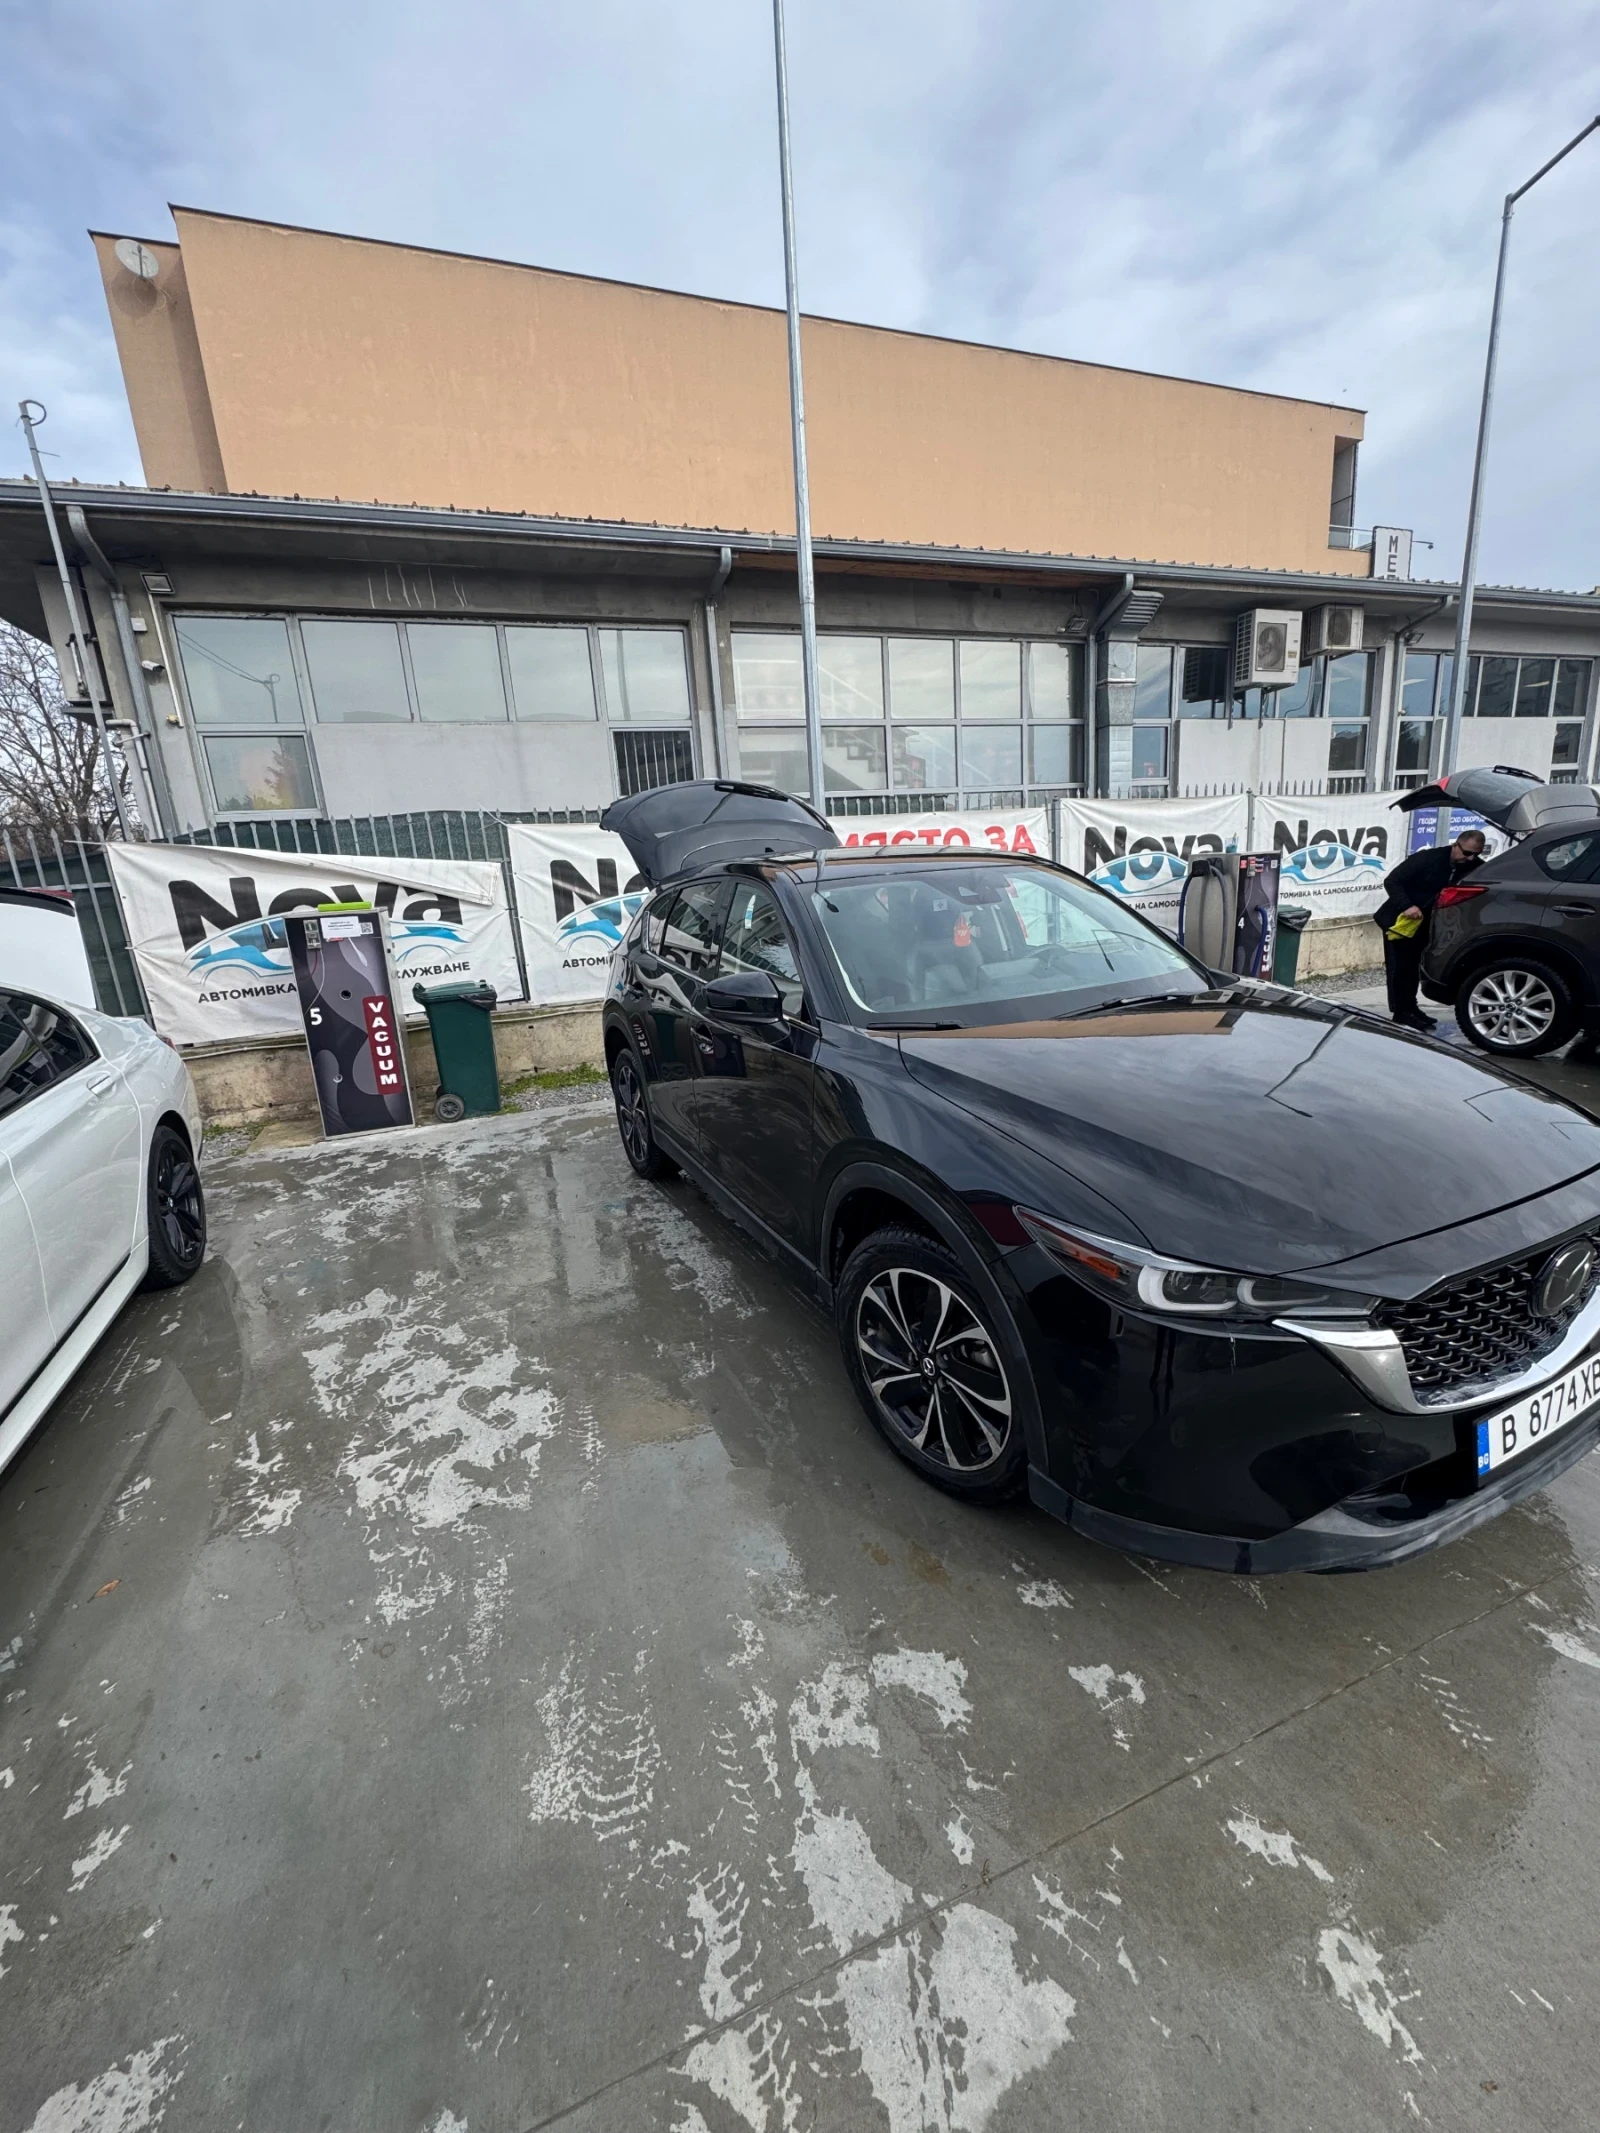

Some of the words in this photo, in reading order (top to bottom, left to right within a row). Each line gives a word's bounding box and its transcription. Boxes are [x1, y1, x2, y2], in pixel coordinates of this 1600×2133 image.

[984, 825, 1037, 854] ЗА
[1273, 819, 1388, 870] Nova
[1280, 889, 1311, 899] ТОМИВКА
[1313, 888, 1322, 896] НА
[1135, 902, 1147, 910] НА
[1238, 917, 1245, 929] 4
[198, 984, 297, 1004] АВТОМИВКА
[310, 1007, 322, 1026] 5
[368, 1001, 398, 1085] VACUUM
[1502, 1414, 1517, 1455] B
[1529, 1375, 1578, 1437] 8774
[1478, 1453, 1489, 1469] BG
